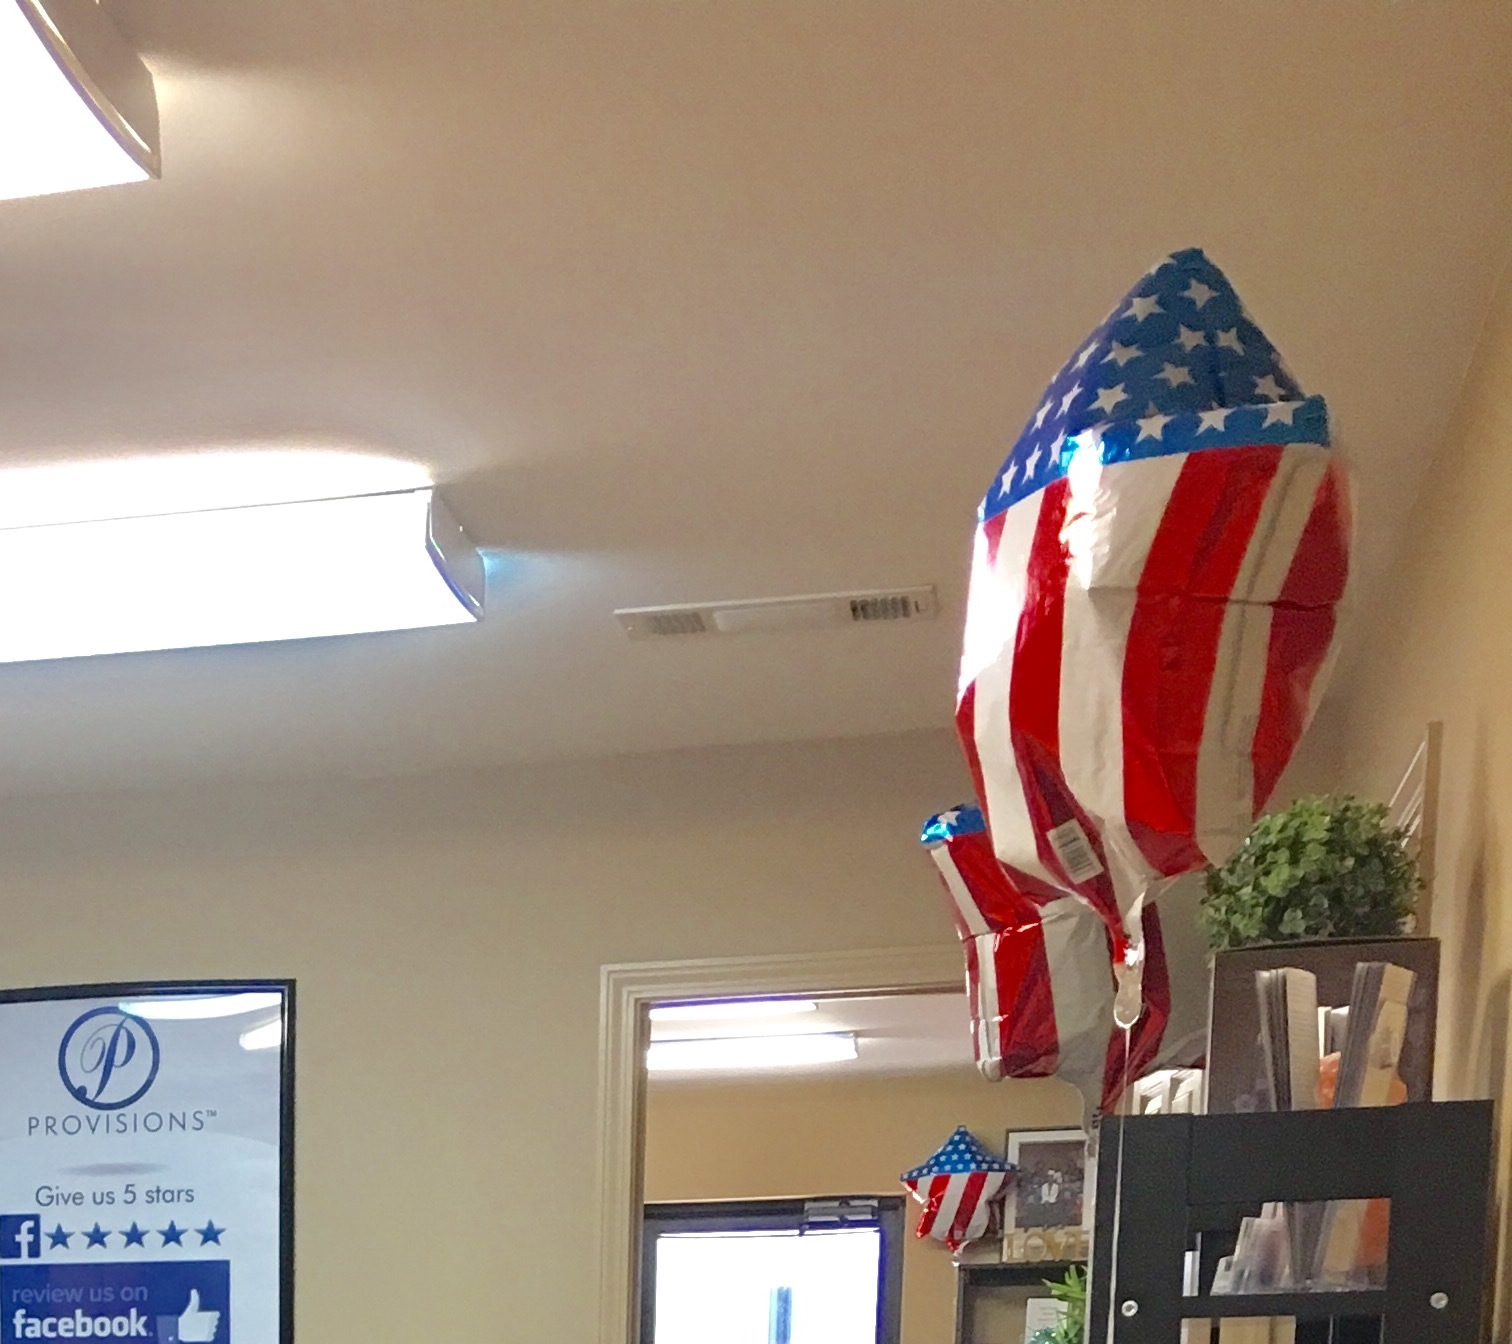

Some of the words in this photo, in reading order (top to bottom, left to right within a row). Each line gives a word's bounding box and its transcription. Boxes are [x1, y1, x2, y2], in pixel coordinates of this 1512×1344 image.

[35, 1185, 84, 1207] Give
[92, 1194, 115, 1206] us
[123, 1183, 136, 1205] 5
[145, 1185, 195, 1204] stars
[12, 1283, 83, 1303] review
[90, 1286, 114, 1302] us
[120, 1285, 148, 1301] on
